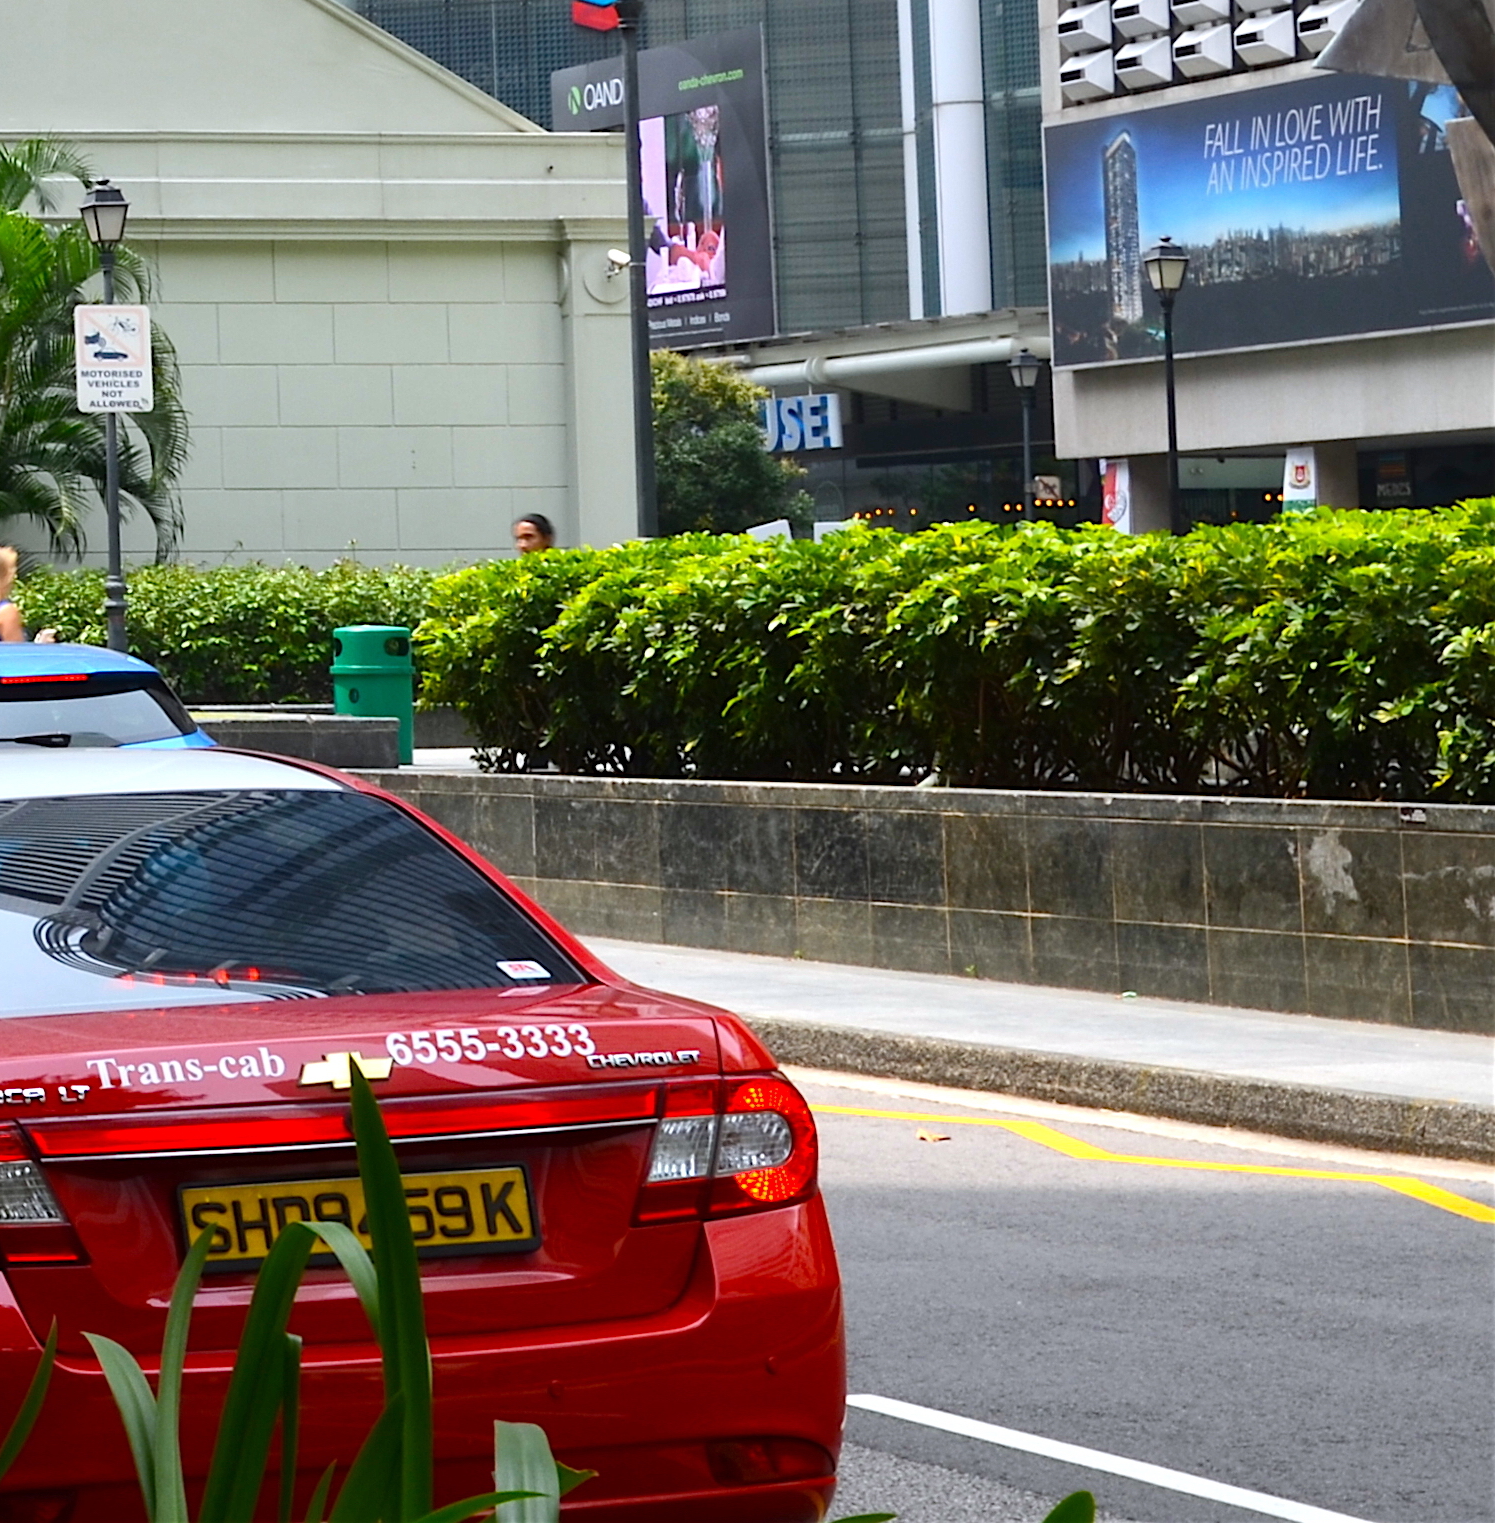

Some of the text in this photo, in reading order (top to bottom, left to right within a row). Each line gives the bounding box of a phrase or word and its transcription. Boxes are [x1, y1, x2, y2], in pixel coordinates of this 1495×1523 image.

[583, 78, 624, 111] OAND
[1204, 94, 1382, 159] FALL IN LOVE WITH
[1206, 133, 1384, 196] AN INSPIRED LIFE.
[81, 370, 143, 378] MOTORISED
[88, 380, 140, 388] VEHICLES
[89, 400, 141, 408] ALLOWED
[102, 390, 123, 398] NOT
[85, 1023, 598, 1091] Trans-cab 6555-3333
[587, 1049, 700, 1070] CHEVROLET
[57, 1084, 91, 1103] LT
